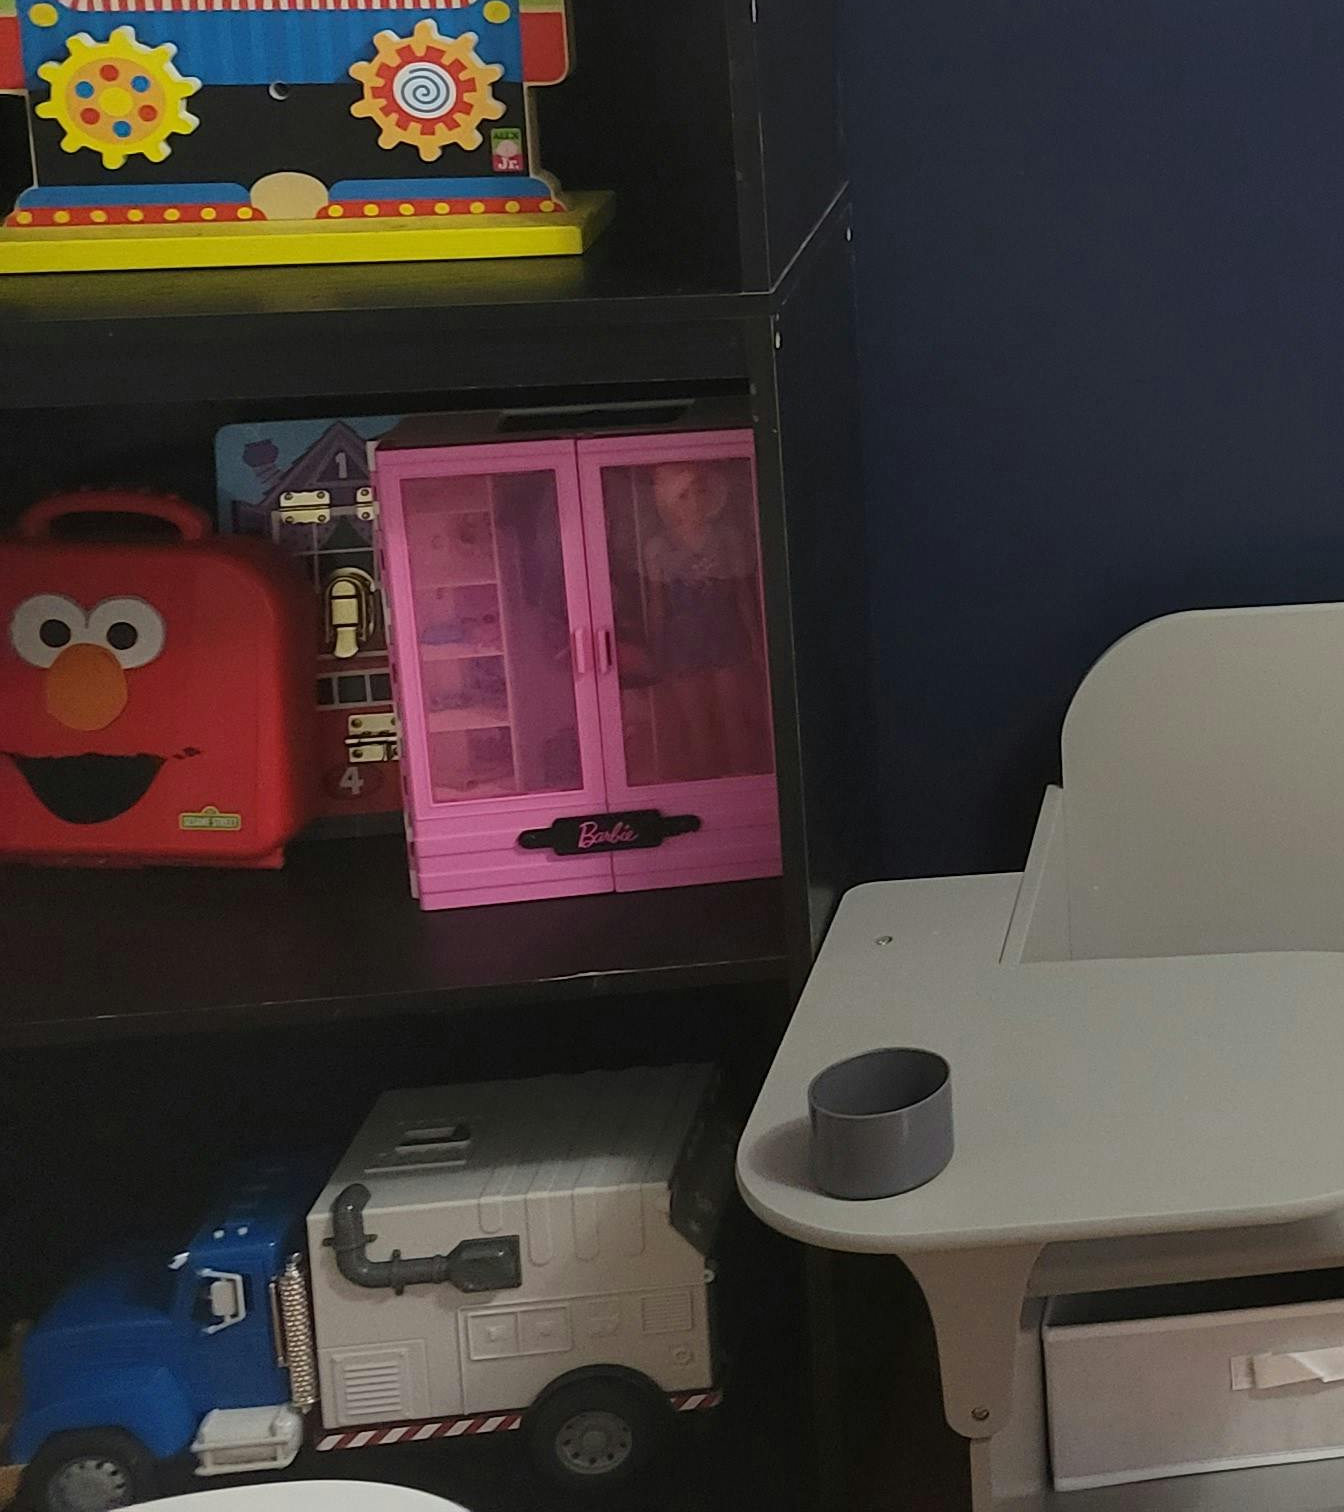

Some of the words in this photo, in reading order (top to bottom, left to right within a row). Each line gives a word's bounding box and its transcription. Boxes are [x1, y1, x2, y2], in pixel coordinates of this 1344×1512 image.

[334, 451, 347, 479] 1
[338, 766, 364, 796] 4
[577, 821, 639, 849] Barbie
